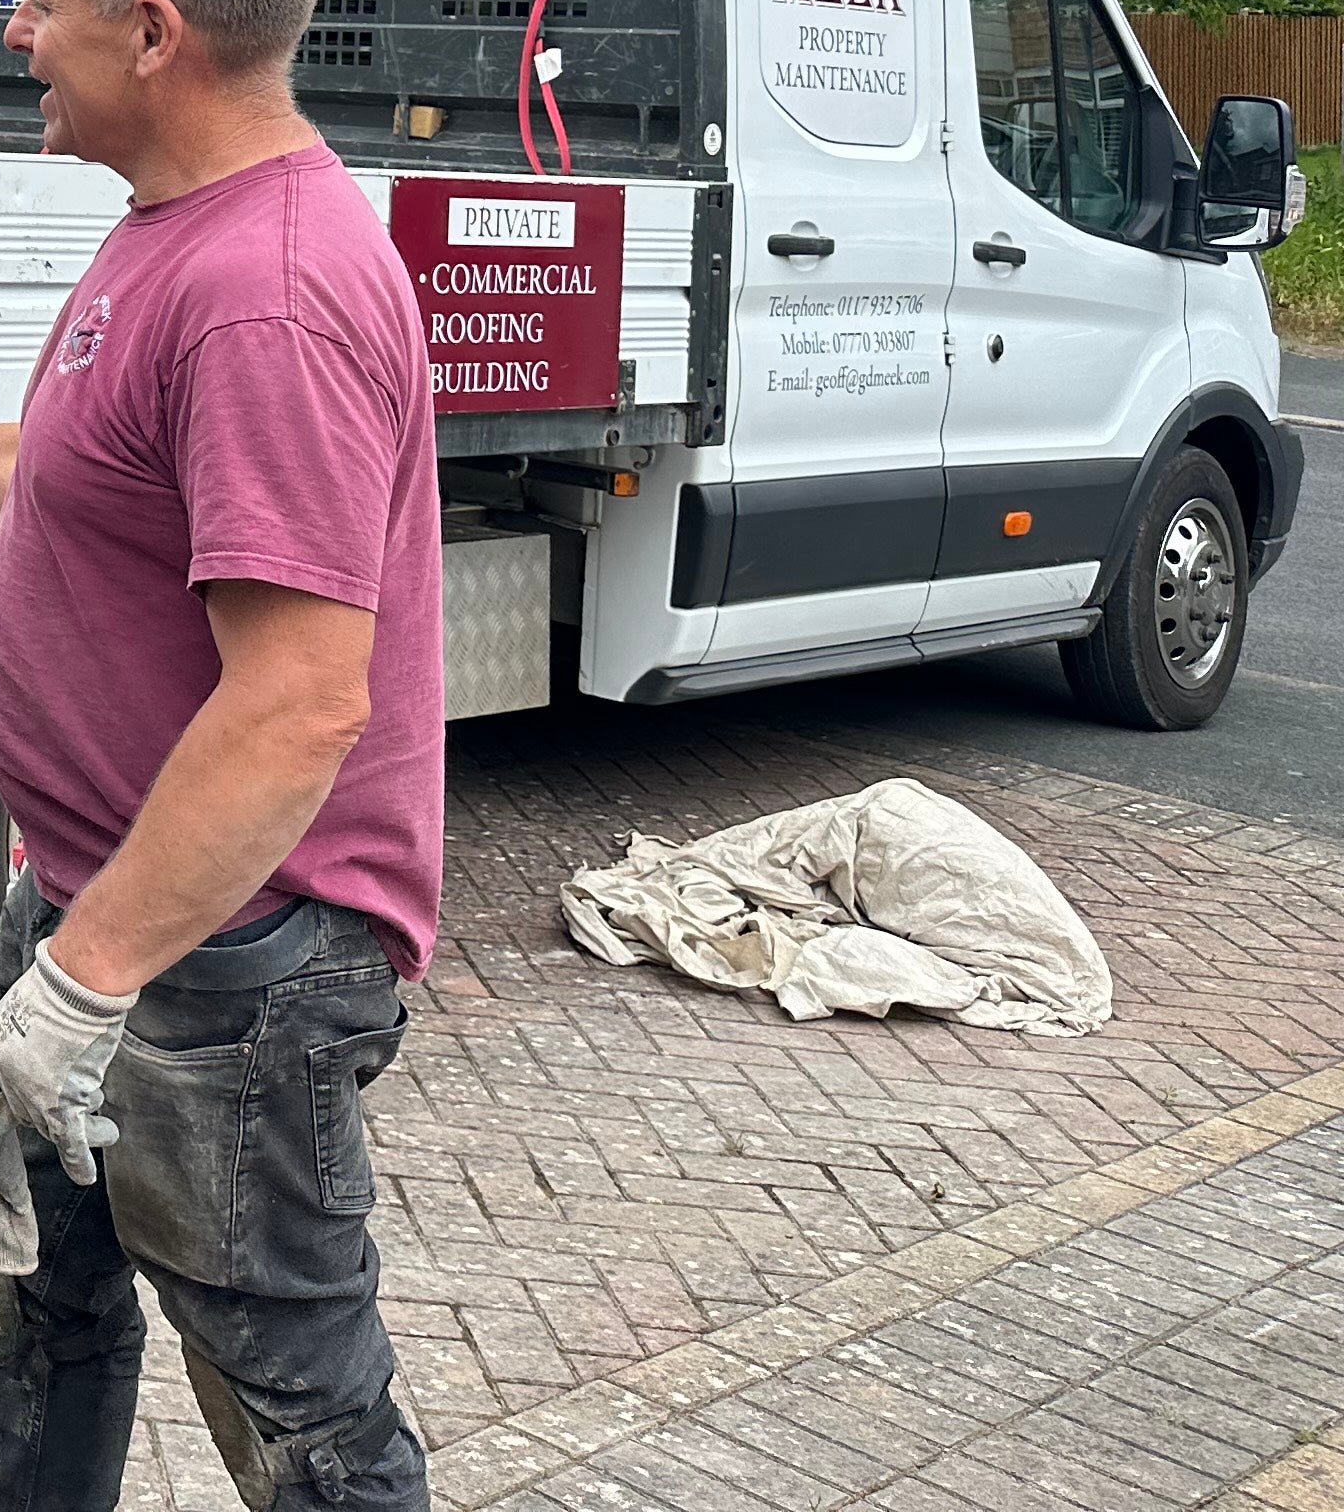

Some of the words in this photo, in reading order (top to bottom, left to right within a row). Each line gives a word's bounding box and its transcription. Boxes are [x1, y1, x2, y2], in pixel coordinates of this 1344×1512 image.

[798, 25, 887, 57] PROPERTY
[774, 61, 907, 96] MAINTENANCE
[463, 206, 561, 239] PRIVATE
[431, 262, 597, 295] COMMERCIAL
[768, 294, 835, 325] Telephone:
[837, 295, 869, 317] 0117
[870, 294, 893, 317] 932
[894, 293, 926, 316] 5706
[429, 312, 544, 344] ROOFING
[780, 330, 831, 355] Mobile:
[832, 332, 871, 355] 07770
[873, 329, 916, 354] 303807
[429, 360, 549, 394] BUILDING
[767, 367, 813, 392] E-mail:
[815, 363, 930, 398] geoff@gdmeek.com
